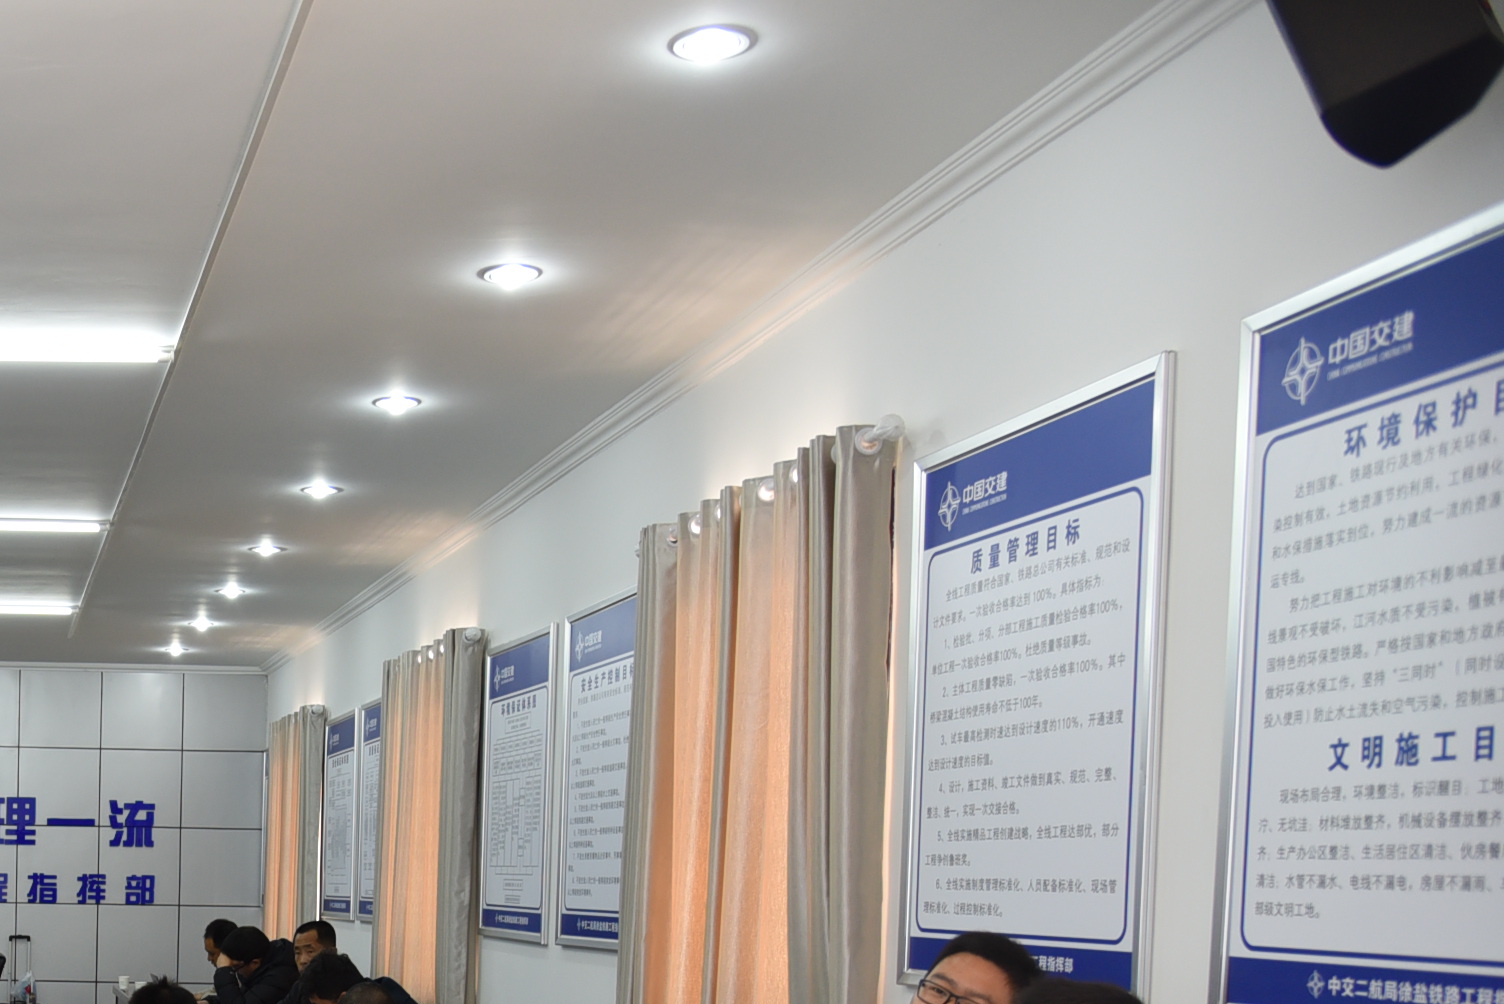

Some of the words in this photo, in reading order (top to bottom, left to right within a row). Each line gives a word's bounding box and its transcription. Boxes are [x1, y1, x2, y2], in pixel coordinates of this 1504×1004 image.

[1327, 309, 1415, 365] 中国交建
[962, 470, 1008, 505] 中国交建
[970, 518, 1081, 575] 质量管理目标
[1327, 725, 1495, 771] 文明施工目
